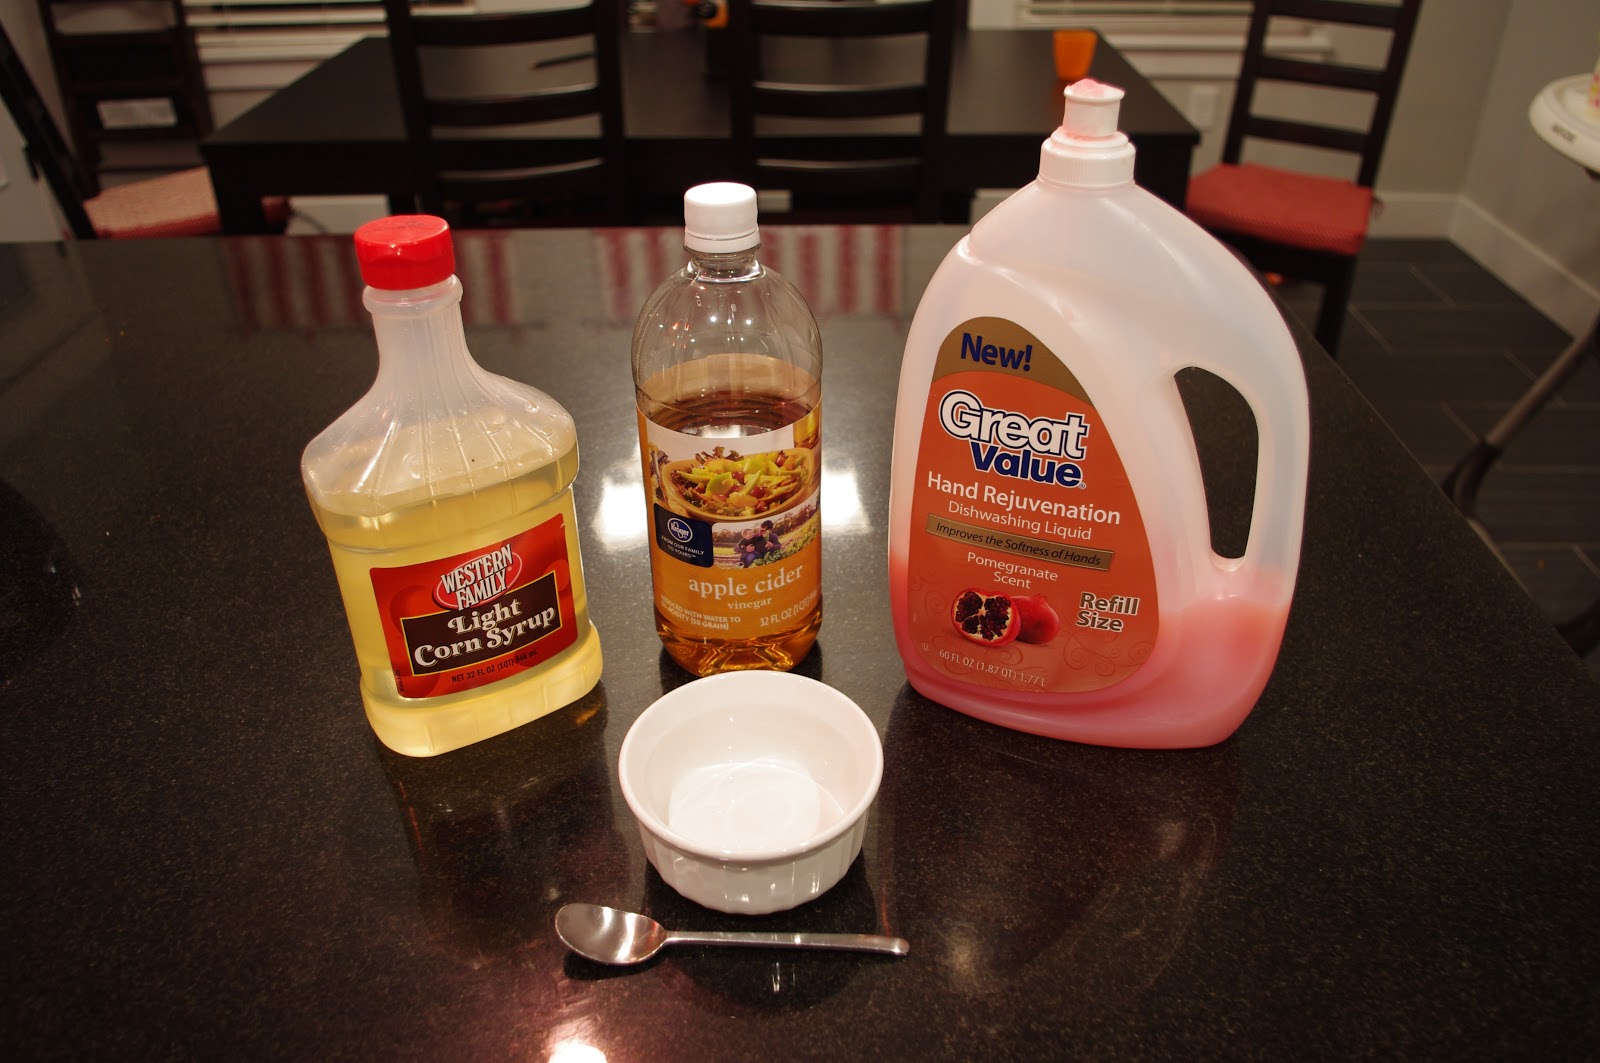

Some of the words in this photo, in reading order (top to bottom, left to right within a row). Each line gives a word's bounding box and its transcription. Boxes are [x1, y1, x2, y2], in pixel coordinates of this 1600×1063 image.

[960, 332, 1033, 372] New!
[939, 389, 1090, 460] Great
[969, 440, 1083, 488] Value
[927, 471, 978, 500] Hand
[983, 485, 1121, 525] Rejuvenation
[948, 500, 1041, 534] Dishwashing
[1044, 520, 1092, 540] Liquid
[685, 546, 704, 556] FAMILY
[936, 522, 983, 542] Improves
[985, 534, 1003, 546] the
[1004, 538, 1049, 557] Softness
[1051, 550, 1066, 559] of
[1066, 552, 1102, 566] Hands
[441, 543, 514, 595] WESTERN
[688, 577, 748, 600] apple
[754, 564, 804, 594] cider
[967, 552, 1058, 582] Pomegranate
[993, 572, 1031, 590] Scent
[455, 568, 508, 612] FAMILY
[728, 596, 773, 610] vinegar
[1079, 591, 1140, 616] Refill
[447, 599, 522, 635] Light
[684, 608, 702, 619] WITH
[703, 614, 728, 622] WATER
[702, 620, 729, 630] GRAIN)
[760, 616, 768, 626] 32
[770, 614, 780, 624] FL
[780, 608, 792, 620] OZ
[1076, 610, 1124, 633] Size
[414, 634, 483, 668] Corn
[486, 606, 556, 650] Syrup
[451, 674, 464, 683] NET
[466, 672, 476, 680] 32
[486, 665, 496, 674] OZ
[515, 654, 528, 663] 946
[939, 650, 950, 660] 60
[951, 654, 960, 664] FL
[962, 656, 975, 668] OZ
[976, 661, 1000, 675] (1.87
[1001, 668, 1017, 680] QT)
[1020, 672, 1040, 685] 1.77
[1041, 678, 1046, 686] L
